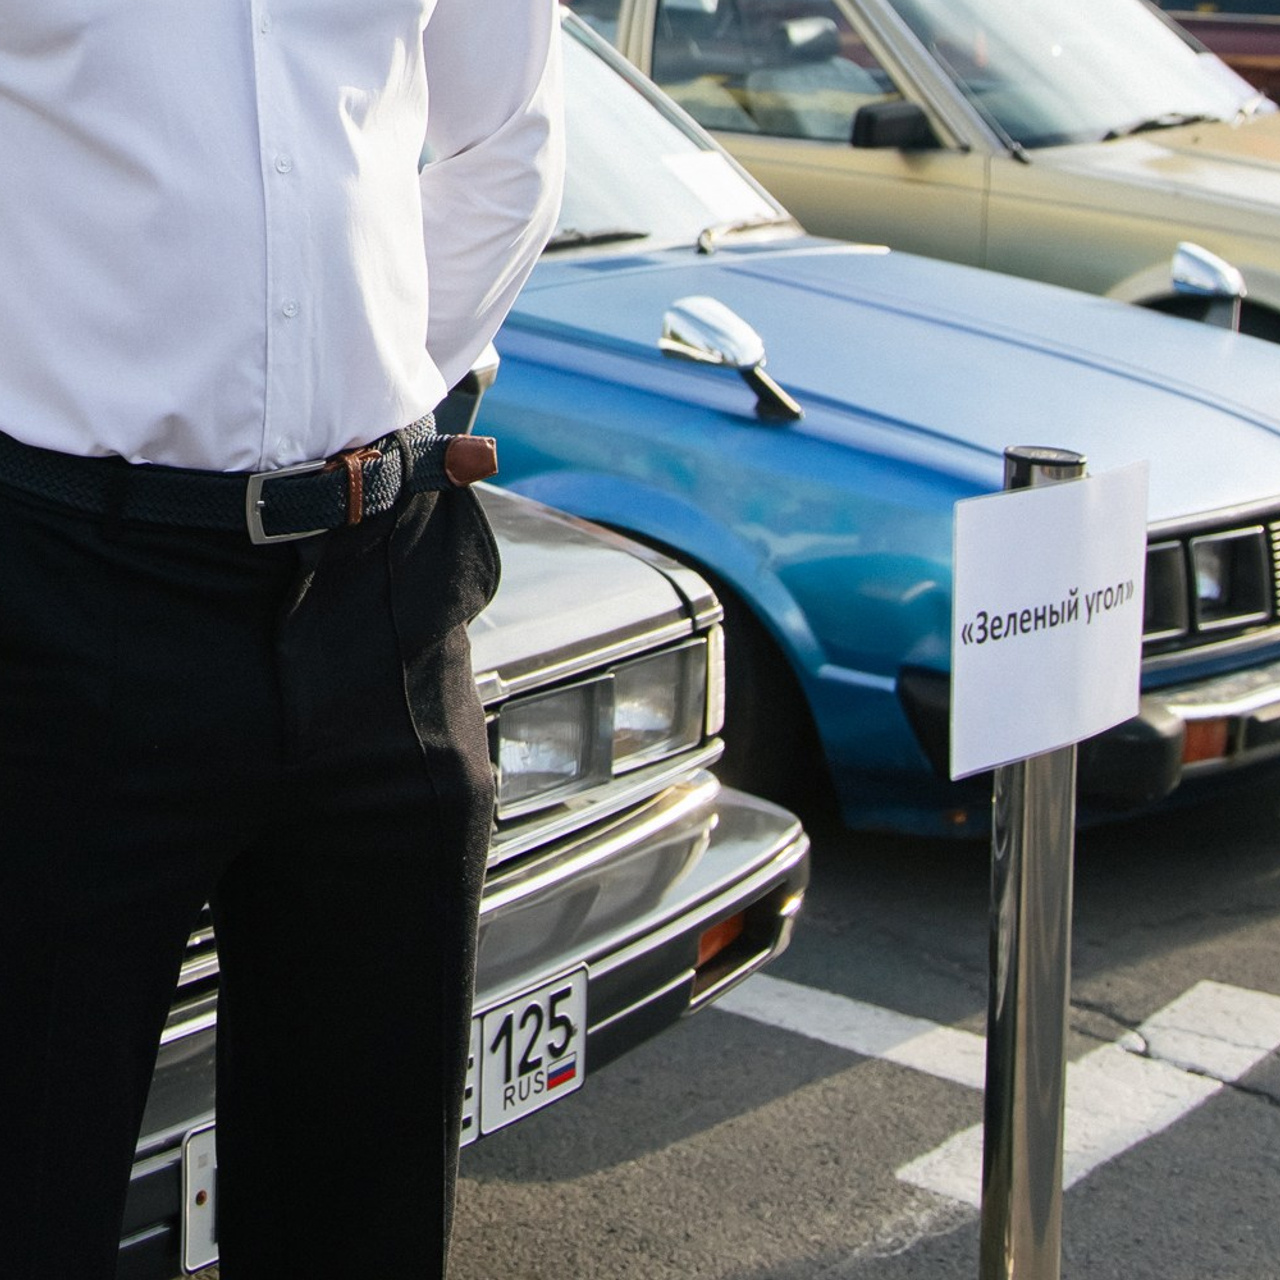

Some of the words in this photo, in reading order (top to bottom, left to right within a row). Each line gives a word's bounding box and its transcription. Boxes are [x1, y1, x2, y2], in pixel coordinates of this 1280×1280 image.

[961, 587, 1079, 646] «Зеленый
[1085, 579, 1135, 625] угол»
[490, 982, 574, 1085] 125
[504, 1070, 545, 1111] RUS
